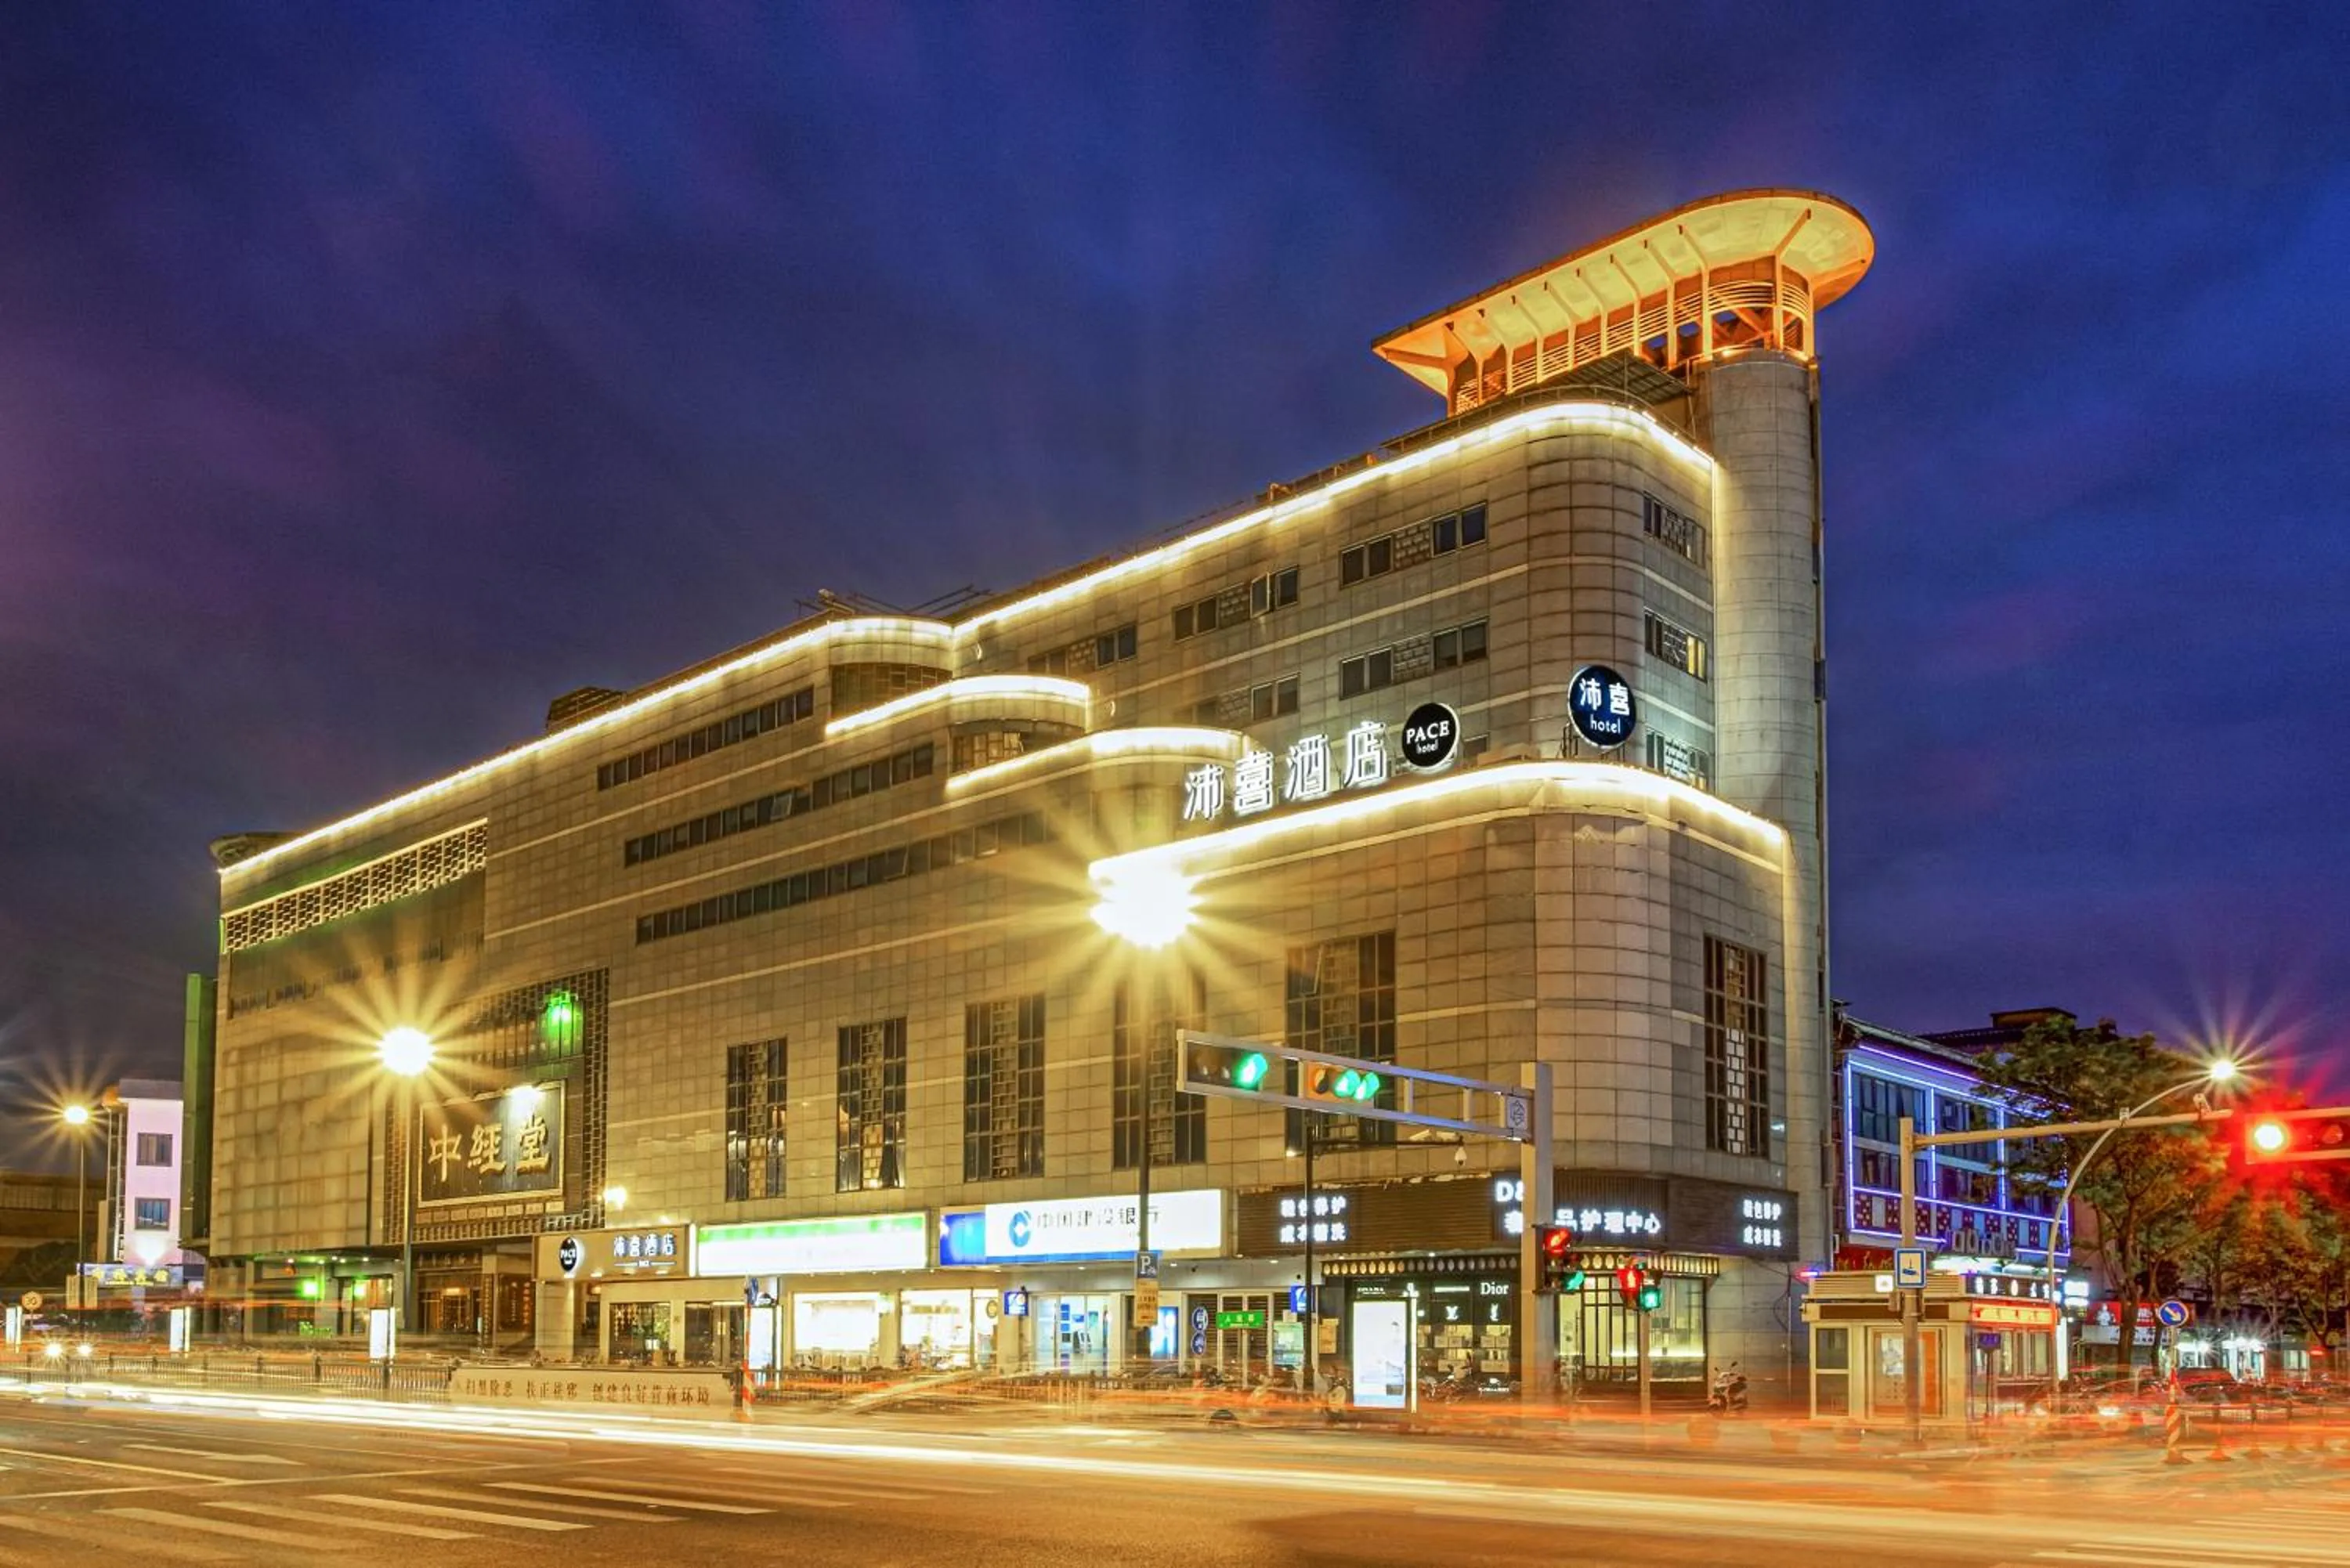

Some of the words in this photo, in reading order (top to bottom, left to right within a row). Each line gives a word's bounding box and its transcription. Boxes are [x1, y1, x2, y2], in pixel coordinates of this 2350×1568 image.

[1578, 677, 1630, 716] 沛喜
[1406, 720, 1450, 745] PACE
[1589, 714, 1621, 734] hotel
[1184, 719, 1388, 822] 沛喜酒店
[1503, 1208, 1662, 1234] 奢品护理中心
[1141, 1255, 1151, 1275] P
[1480, 1281, 1509, 1295] Dior
